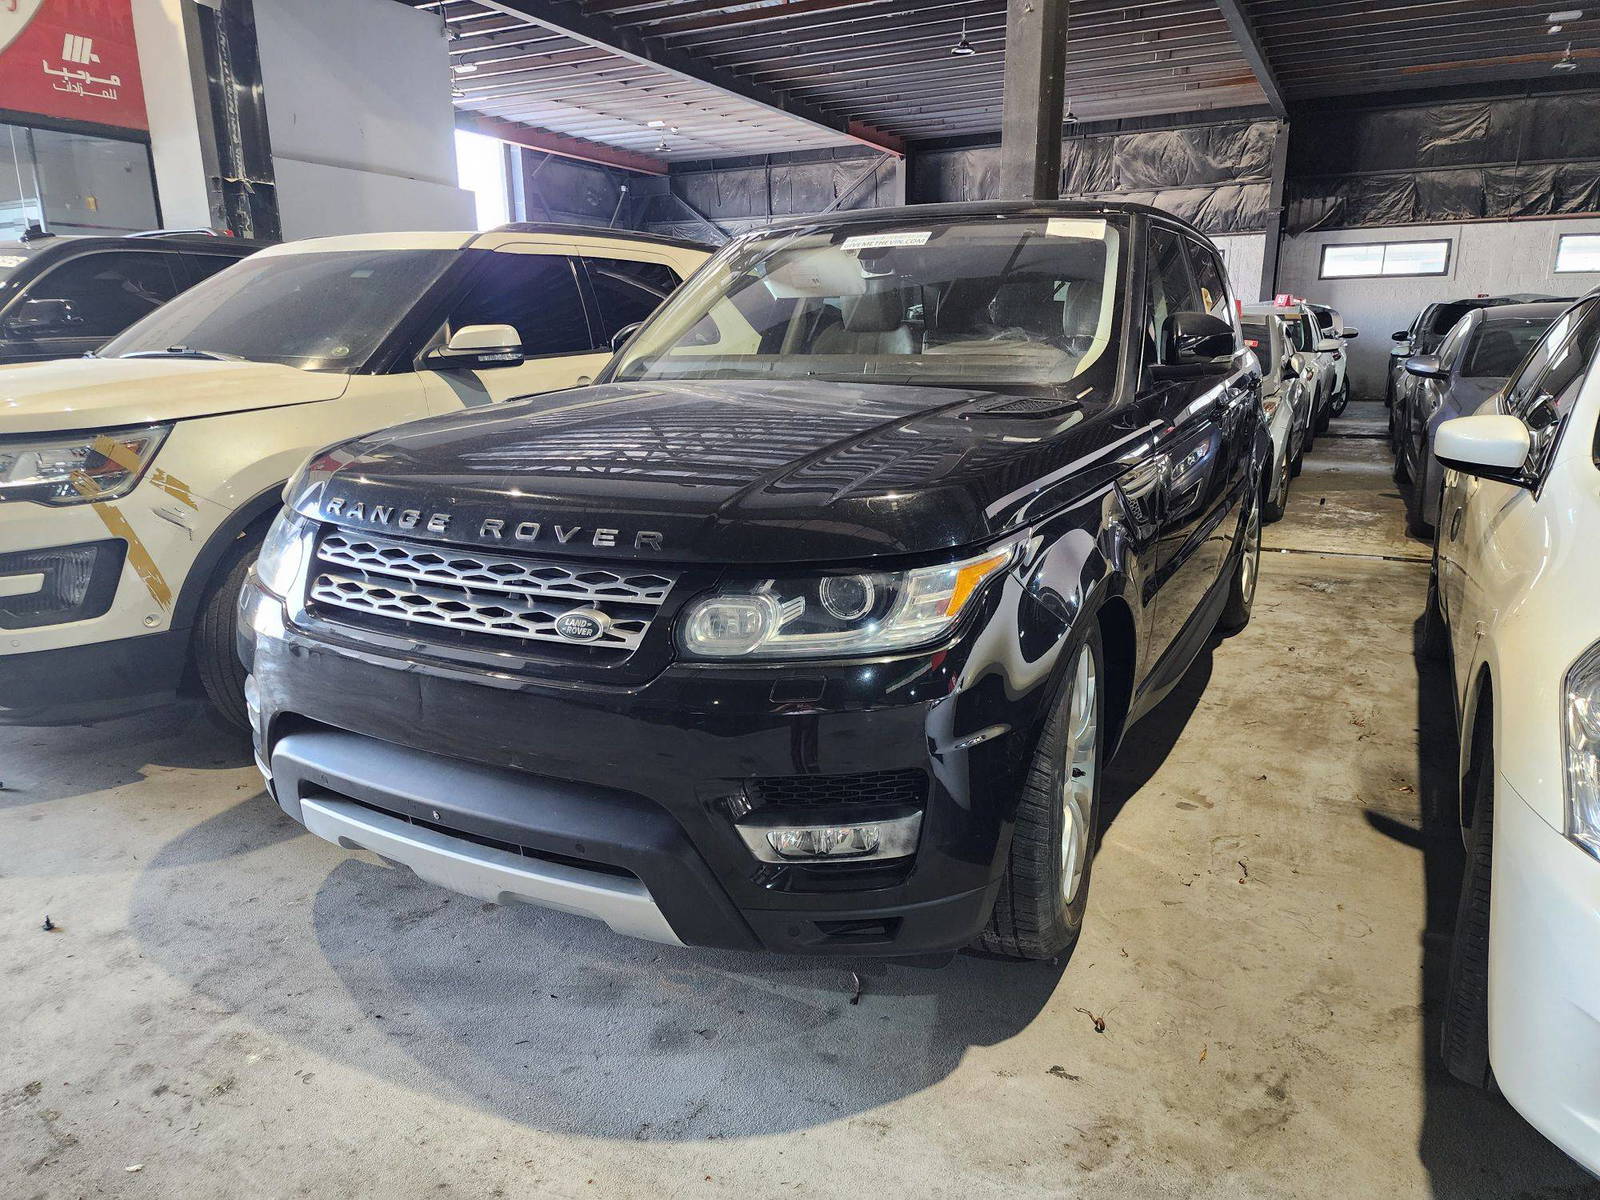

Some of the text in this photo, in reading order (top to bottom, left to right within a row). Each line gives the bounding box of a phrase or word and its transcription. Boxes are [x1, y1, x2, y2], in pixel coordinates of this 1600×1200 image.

[42, 59, 121, 87] مرحبا
[326, 497, 664, 551] RANGE ROVER
[565, 618, 587, 628] LAND
[566, 626, 593, 636] ROVER
